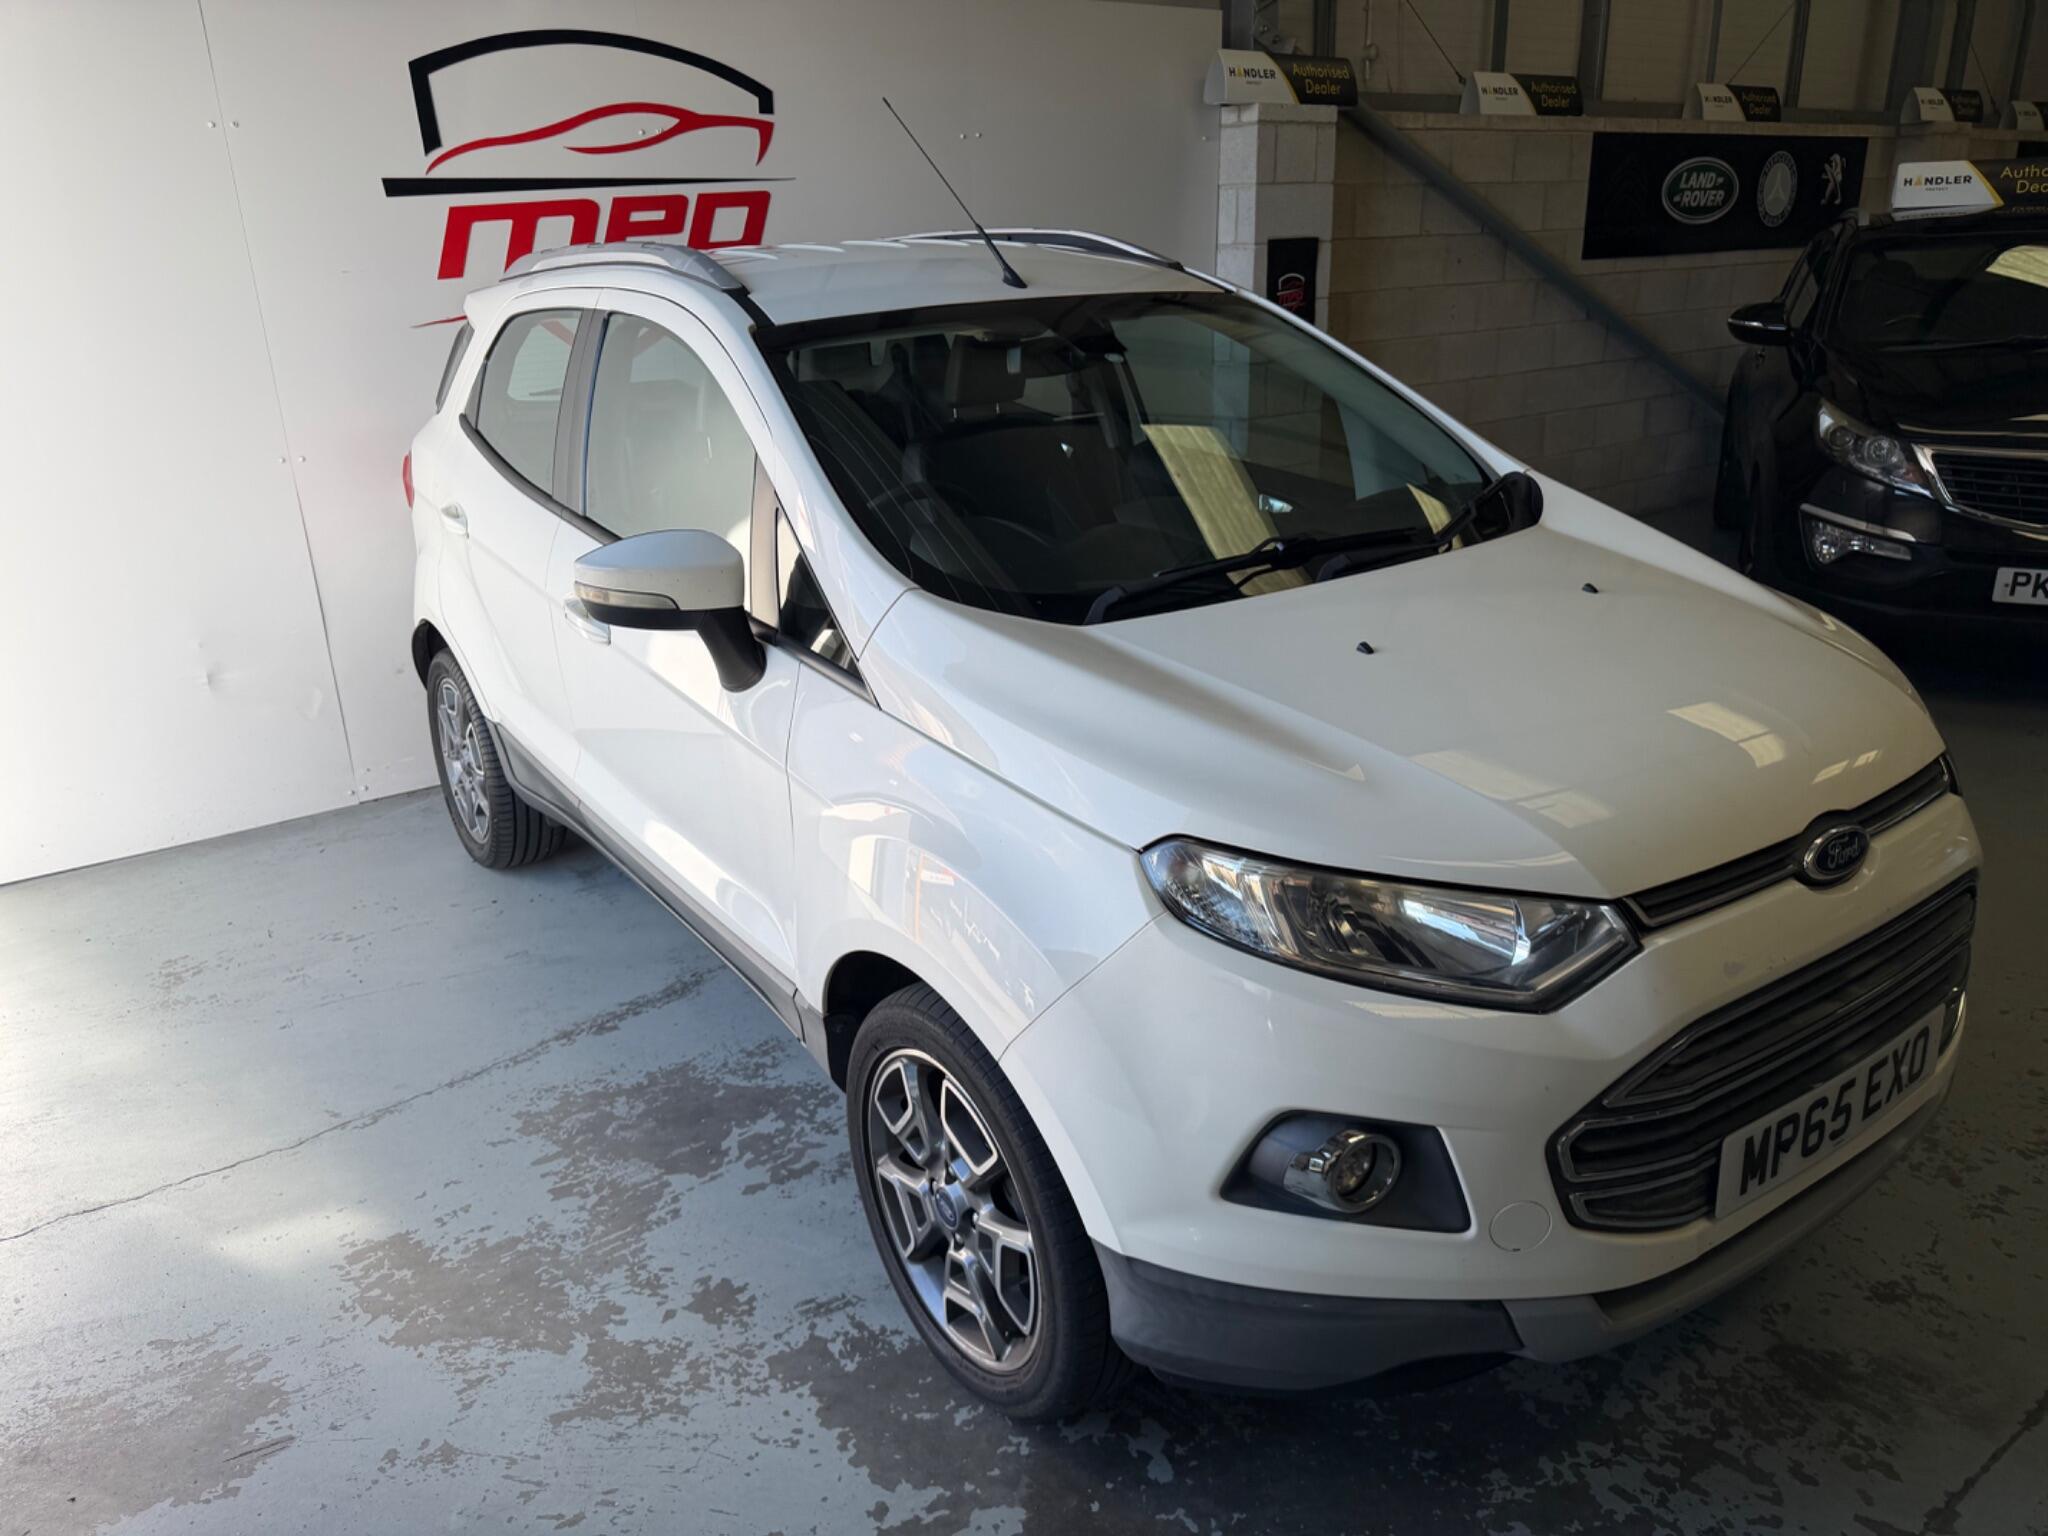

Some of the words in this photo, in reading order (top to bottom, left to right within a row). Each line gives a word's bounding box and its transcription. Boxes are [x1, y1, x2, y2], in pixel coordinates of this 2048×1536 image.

[1229, 66, 1277, 80] HANDLER
[1292, 63, 1350, 80] Authorised
[1305, 79, 1342, 95] Dealer
[1680, 171, 1717, 189] LAND
[1903, 175, 1973, 187] HANDLER
[1680, 189, 1726, 208] ROVER
[2009, 572, 2048, 599] PK
[1827, 835, 1860, 869] Ford
[1740, 1078, 1857, 1196] MP65
[1862, 1025, 1931, 1122] EXO
